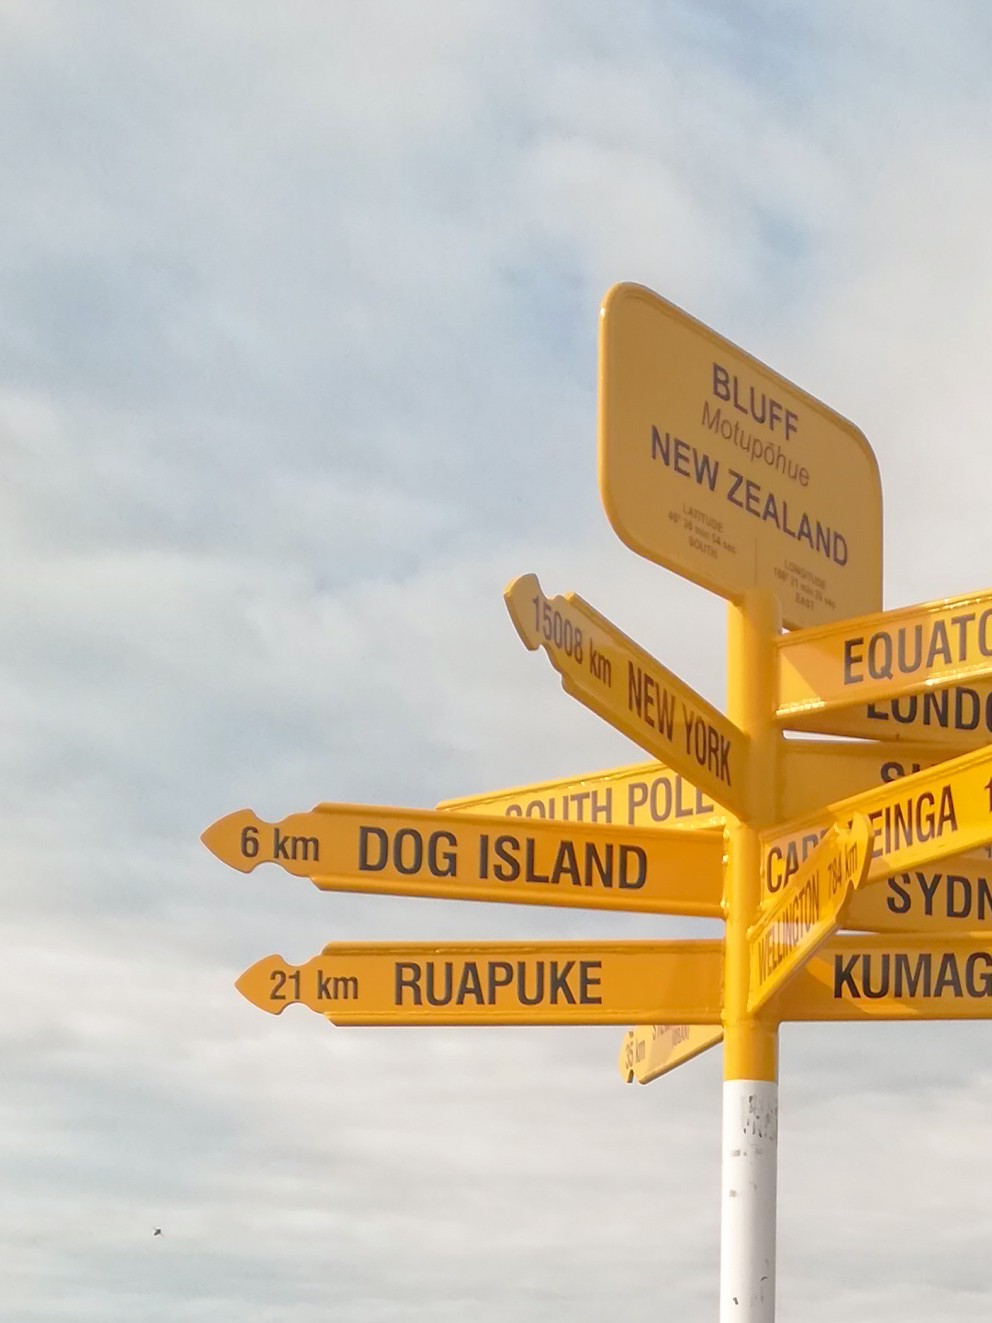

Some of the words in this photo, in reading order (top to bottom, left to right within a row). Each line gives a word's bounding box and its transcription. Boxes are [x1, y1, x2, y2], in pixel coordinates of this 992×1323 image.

[701, 401, 810, 487] Motupōhue
[712, 362, 799, 441] BLUFF
[651, 424, 720, 491] NEW
[727, 468, 848, 567] ZEALAND
[532, 595, 583, 665] 15008
[590, 638, 612, 688] km
[628, 660, 675, 742] NEW
[682, 704, 731, 787] YORK
[240, 826, 259, 858] 6
[273, 828, 320, 863] km
[359, 826, 458, 878] DOG
[480, 834, 647, 890] ISLAND
[767, 829, 828, 893] CAP
[848, 784, 958, 859] EINGA
[758, 870, 819, 985] WELLINGTON
[844, 841, 858, 879] km
[270, 970, 300, 1000] 21
[317, 970, 358, 1000] km
[394, 960, 602, 1006] RUAPUKE
